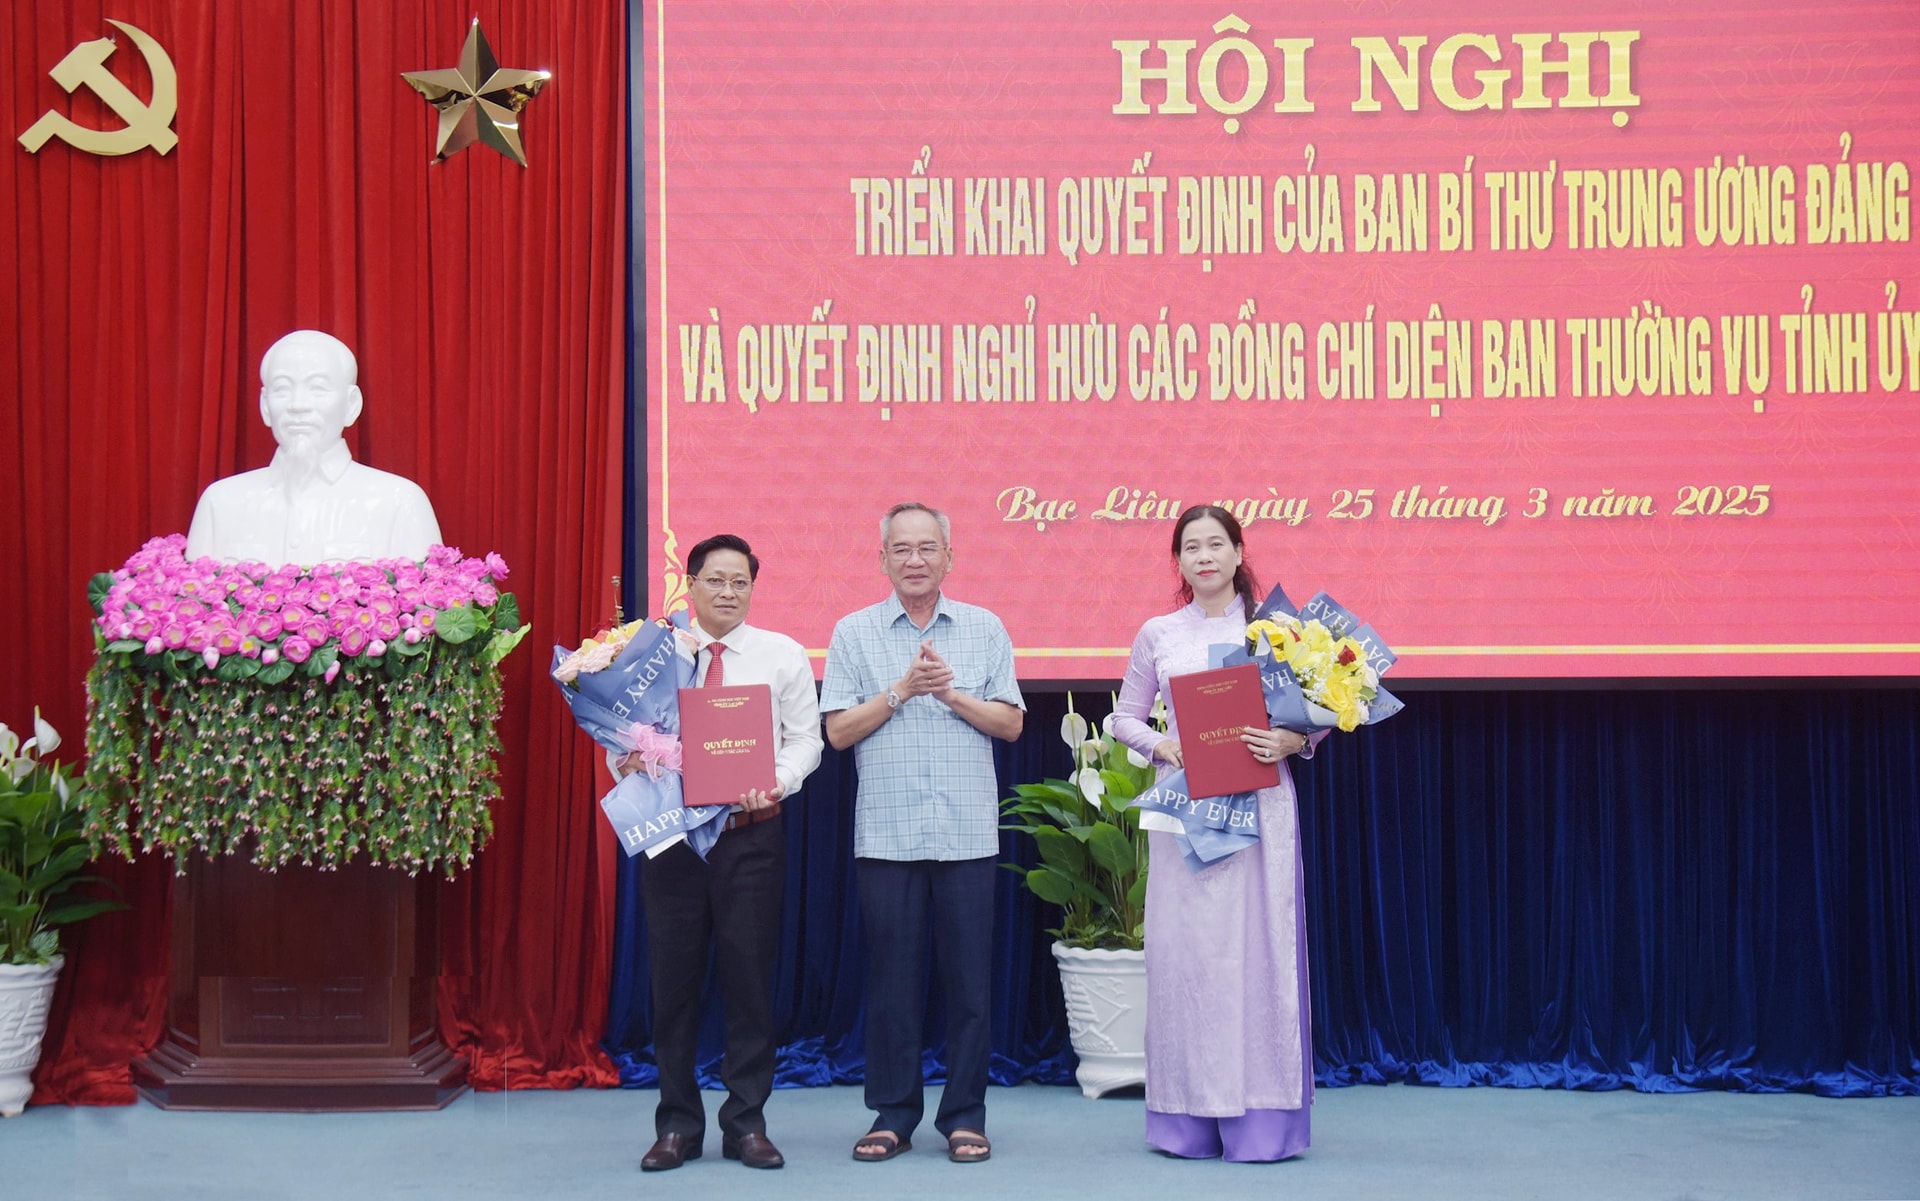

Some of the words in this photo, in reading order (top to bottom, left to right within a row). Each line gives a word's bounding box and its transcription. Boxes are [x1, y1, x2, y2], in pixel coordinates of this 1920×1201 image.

[1112, 13, 1314, 134] HỘI
[1351, 30, 1640, 127] NGHỊ
[850, 145, 953, 255] TRIỂN
[965, 178, 1045, 255] KHAI
[1058, 152, 1167, 266] QUYẾT
[1177, 176, 1262, 272] ĐỊNH
[1274, 144, 1344, 253] CỦA
[1355, 173, 1427, 252] BAN
[1439, 155, 1474, 251] BÍ
[1485, 160, 1556, 250] THƯ
[1563, 168, 1682, 249] TRUNG
[1695, 155, 1795, 246] ƯƠNG
[1806, 132, 1909, 244] ĐẢNG
[679, 308, 726, 402] VÀ
[737, 299, 847, 413] QUYẾT
[856, 325, 940, 420] ĐỊNH
[953, 295, 1035, 402] NGHỈ
[1048, 313, 1116, 401] HƯU
[1128, 307, 1197, 401] CÁC
[1208, 299, 1304, 400] ĐỒNG
[1317, 304, 1374, 399] CHÍ
[1386, 304, 1471, 417] DIỆN
[1483, 319, 1556, 398] BAN
[1566, 300, 1711, 397] THƯỜNG
[1721, 315, 1769, 413] VỤ
[1780, 284, 1866, 393] TỈNH
[1878, 281, 1920, 391] ỦY
[997, 486, 1078, 531] Bạc
[1327, 489, 1375, 519] 25
[1390, 485, 1507, 526] tháng
[1523, 488, 1547, 518] 3
[1563, 488, 1656, 517] năm
[1672, 485, 1770, 515] 2025
[625, 636, 674, 704] HAPPY
[703, 738, 733, 751] QUYẾT
[734, 738, 757, 748] ĐỊNH
